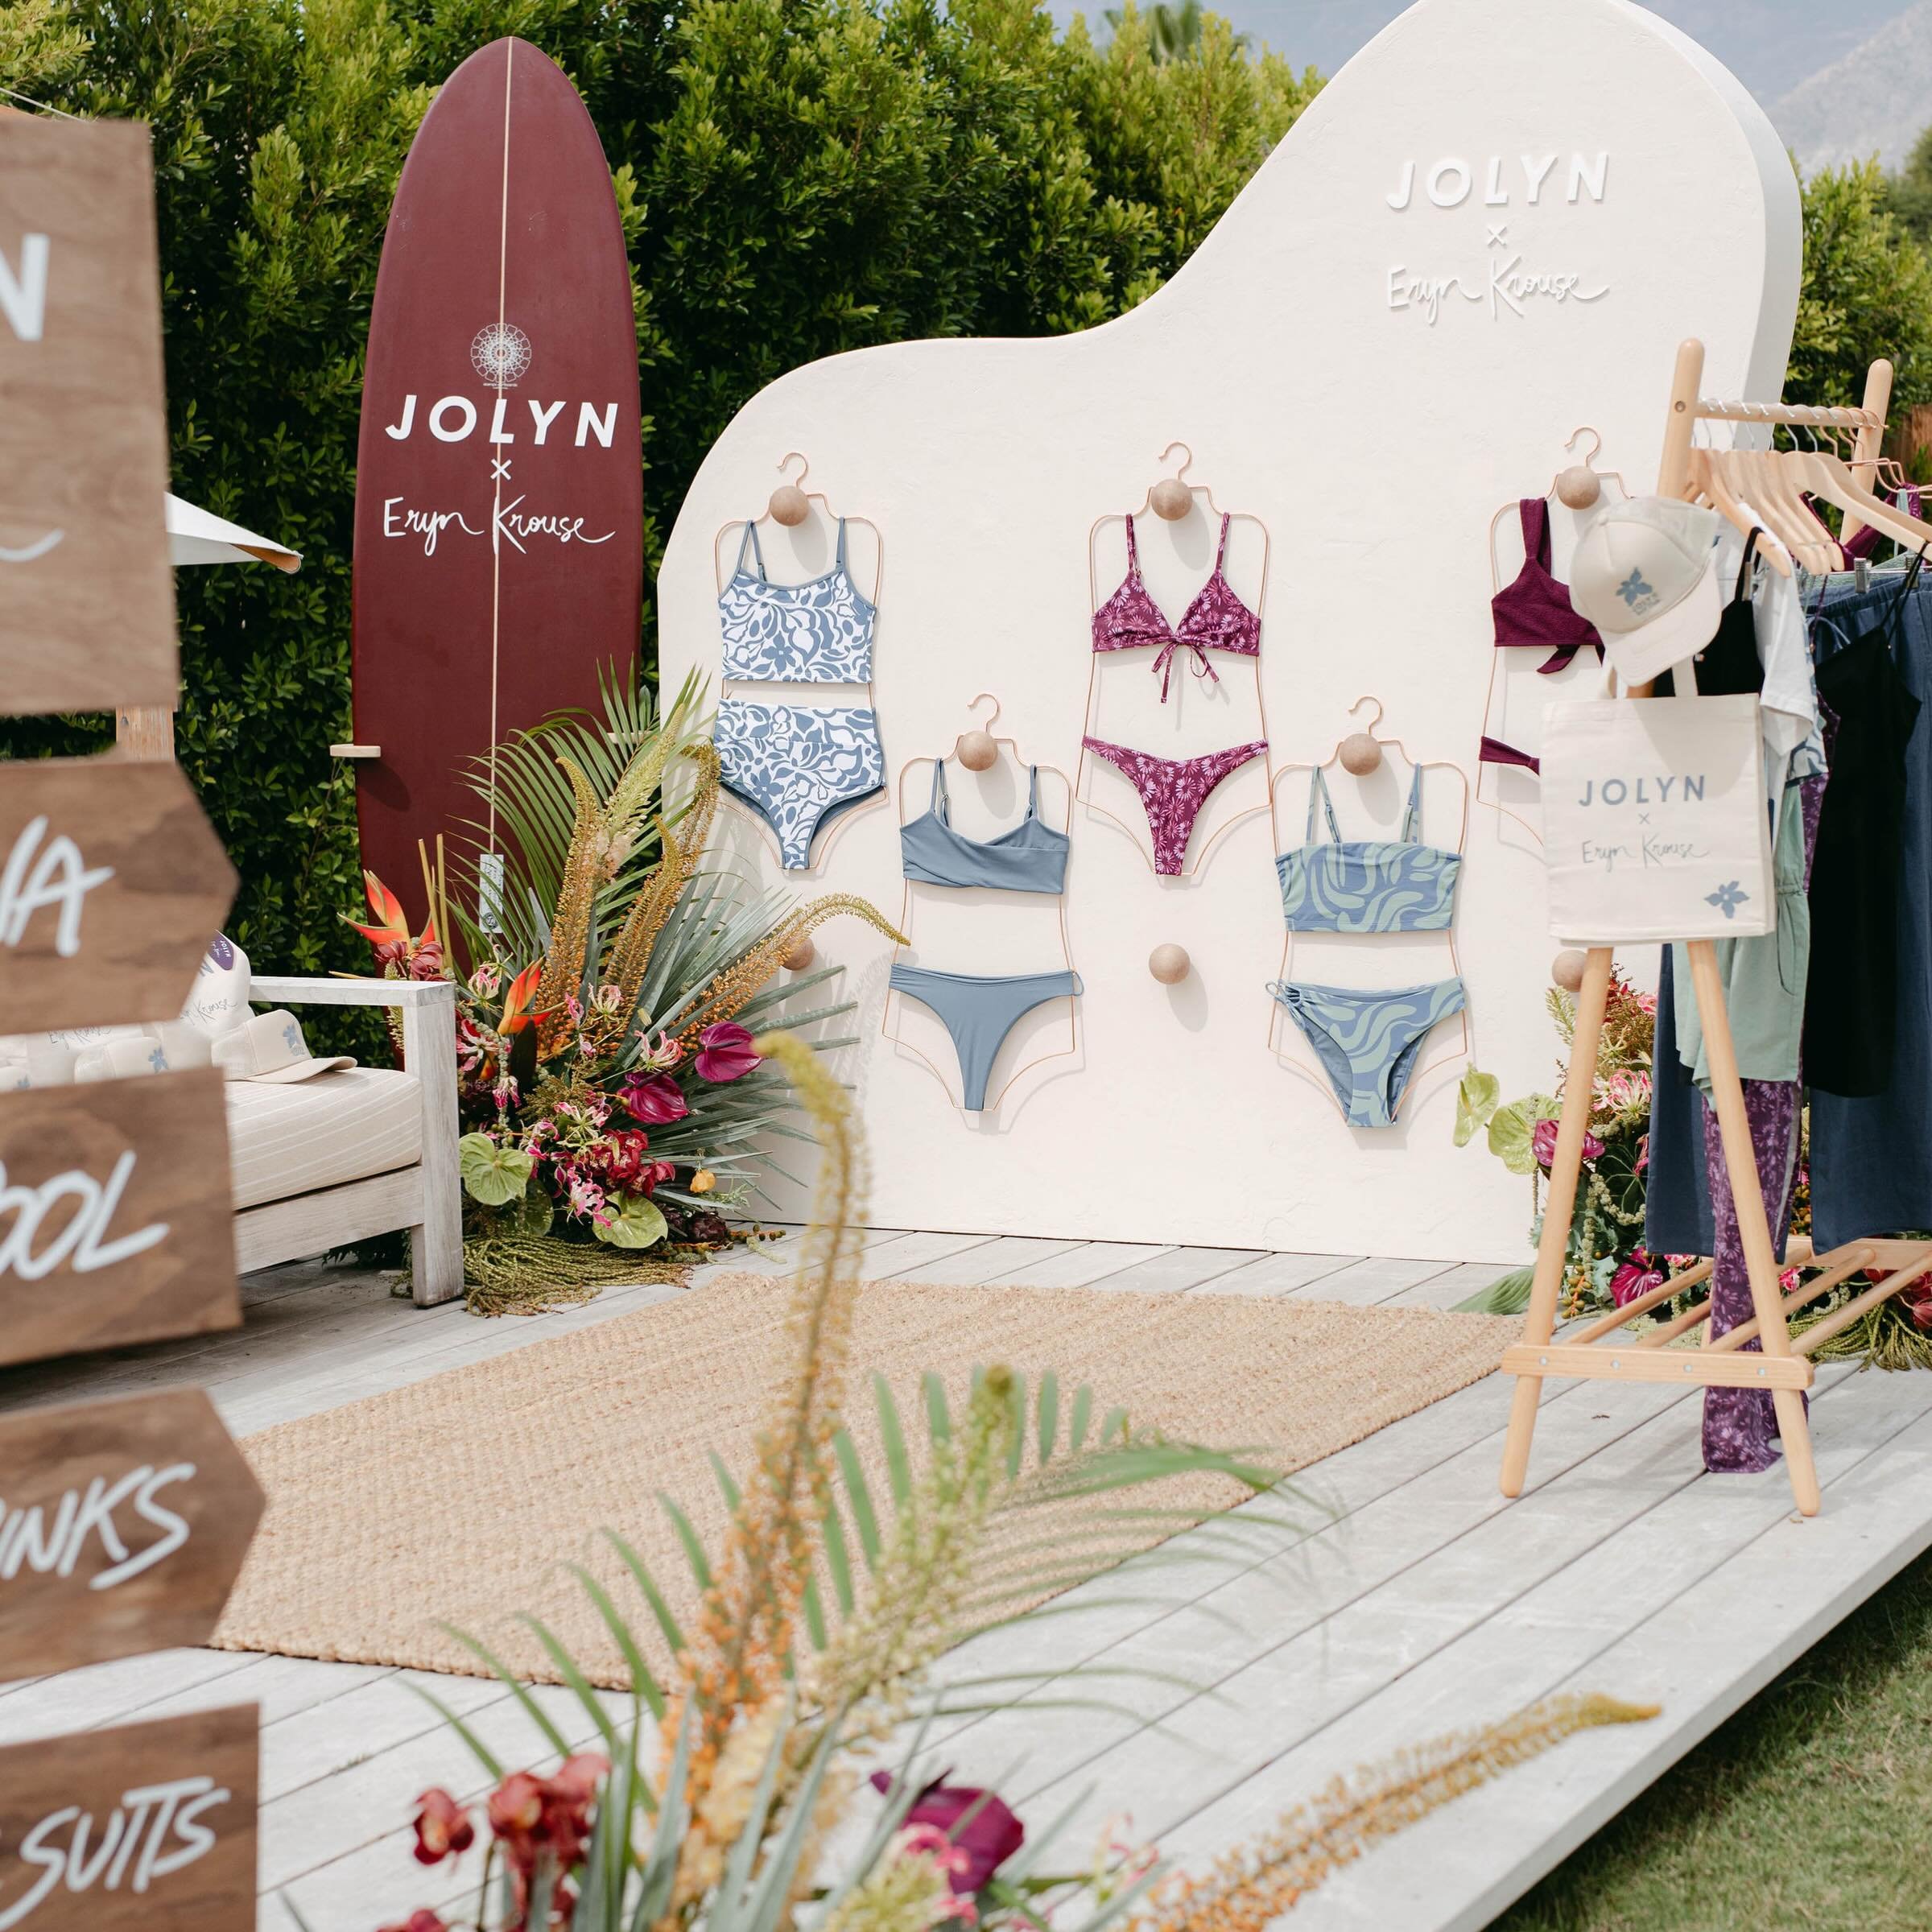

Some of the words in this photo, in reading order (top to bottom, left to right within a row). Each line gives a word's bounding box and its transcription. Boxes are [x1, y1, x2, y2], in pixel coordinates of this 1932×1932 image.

[1386, 152, 1609, 210] JOLYN
[1388, 266, 1483, 325] Eryn
[1489, 255, 1609, 320] Krouse
[385, 394, 618, 448] JOLYN
[384, 497, 484, 555] Eryn
[492, 495, 616, 554] Krouse
[1579, 775, 1705, 806] JOLYN
[1582, 840, 1637, 873] Eryn
[1642, 832, 1711, 869] Krouse
[0, 1462, 197, 1591] INKS
